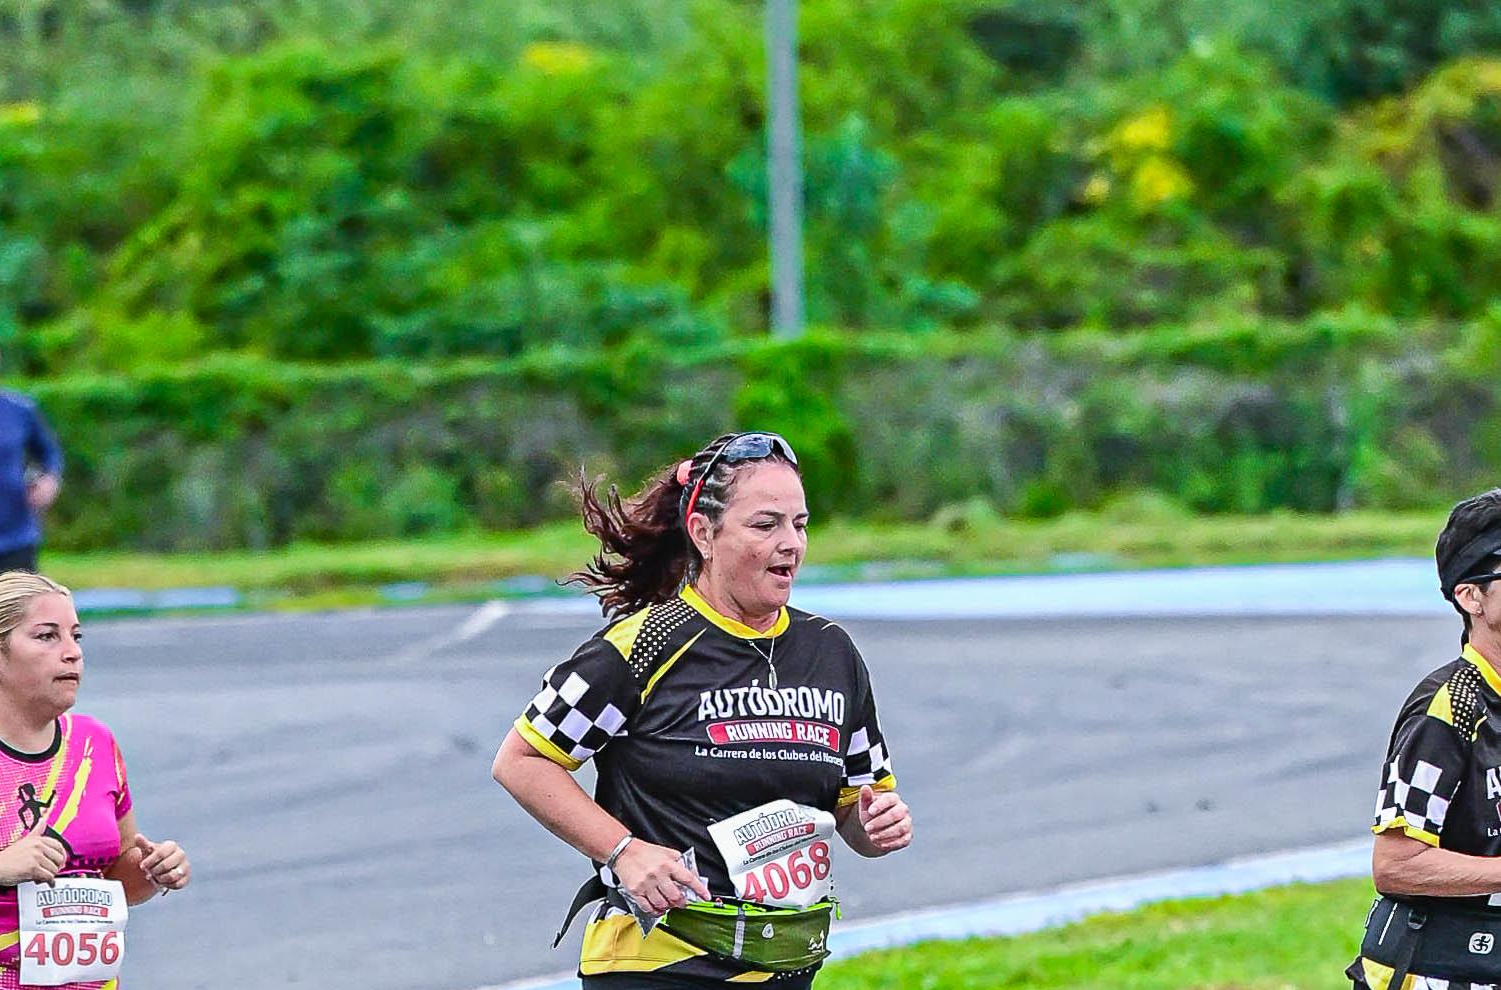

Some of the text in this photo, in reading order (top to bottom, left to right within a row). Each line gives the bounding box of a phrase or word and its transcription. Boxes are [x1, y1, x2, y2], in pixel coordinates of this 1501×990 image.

[698, 678, 845, 726] AUTÓDROMO
[725, 722, 831, 746] RUNNING RACE
[695, 745, 708, 756] La
[710, 747, 748, 759] Carrera
[749, 749, 762, 760] de
[763, 750, 777, 760] los
[778, 749, 809, 761] Clubes
[810, 751, 822, 762] del
[787, 826, 808, 838] RACE
[742, 841, 831, 904] 4068
[36, 884, 113, 907] AUTÓDROMO
[24, 931, 120, 967] 4056
